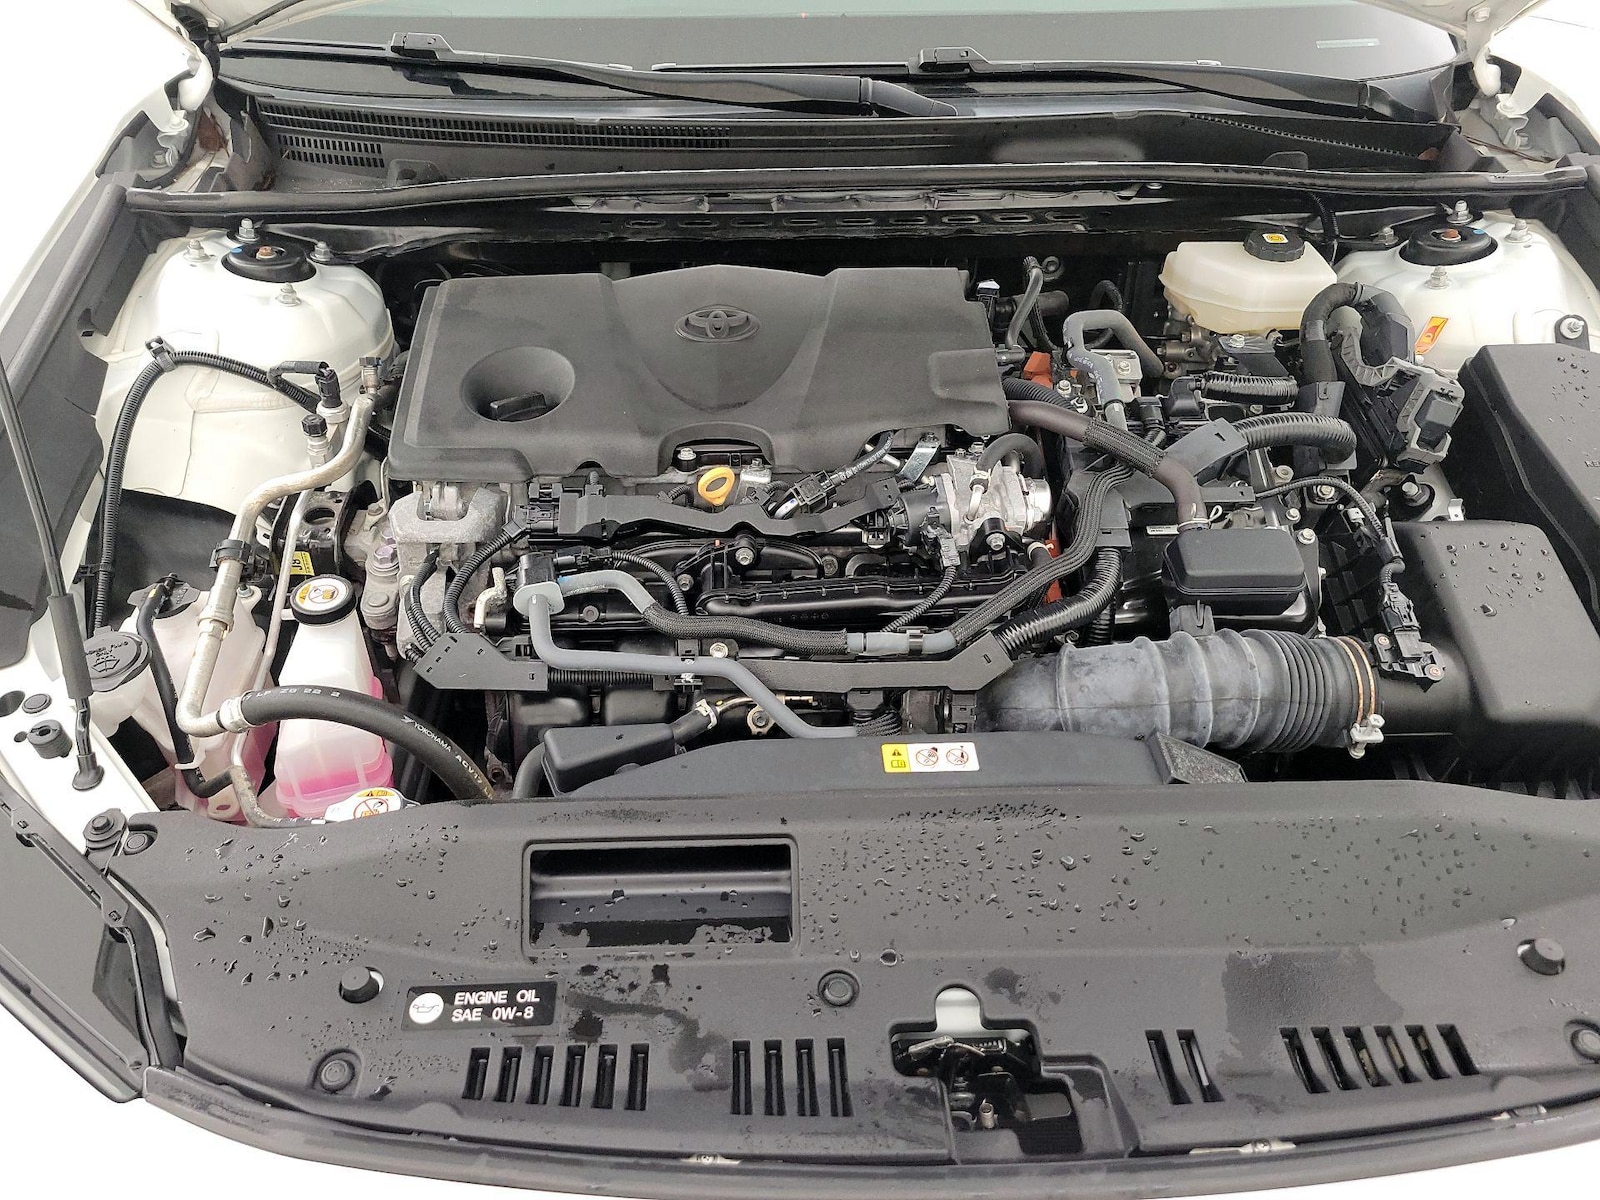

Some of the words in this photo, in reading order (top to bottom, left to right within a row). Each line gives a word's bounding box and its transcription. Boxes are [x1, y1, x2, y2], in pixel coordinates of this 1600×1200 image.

[414, 723, 452, 752] YOKOHAMA
[453, 990, 508, 1005] ENGINE
[516, 989, 540, 1003] OIL
[451, 1007, 483, 1022] SAE
